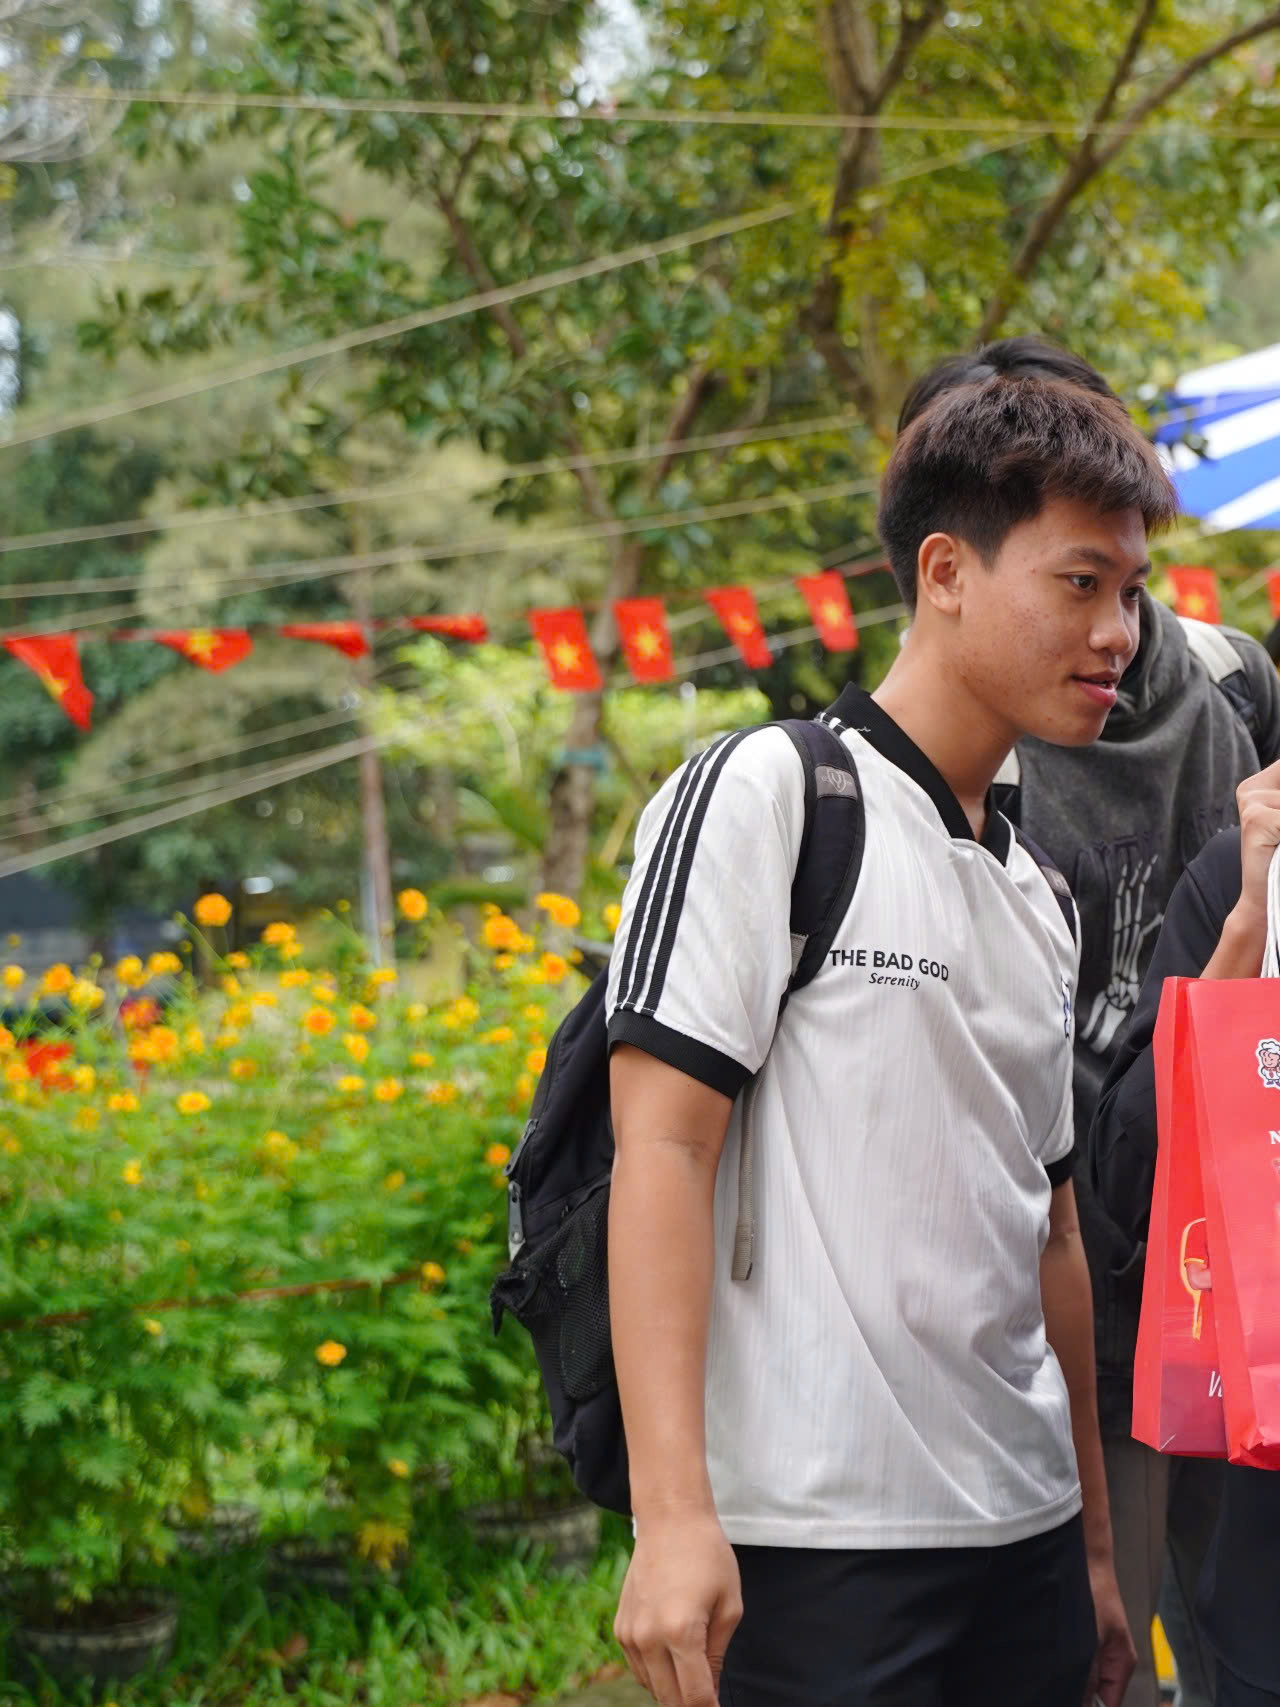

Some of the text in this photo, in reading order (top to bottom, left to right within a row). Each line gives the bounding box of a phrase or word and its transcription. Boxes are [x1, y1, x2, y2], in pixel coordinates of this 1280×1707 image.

[829, 949, 949, 982] THE BAD GOD
[869, 972, 920, 991] Serenity
